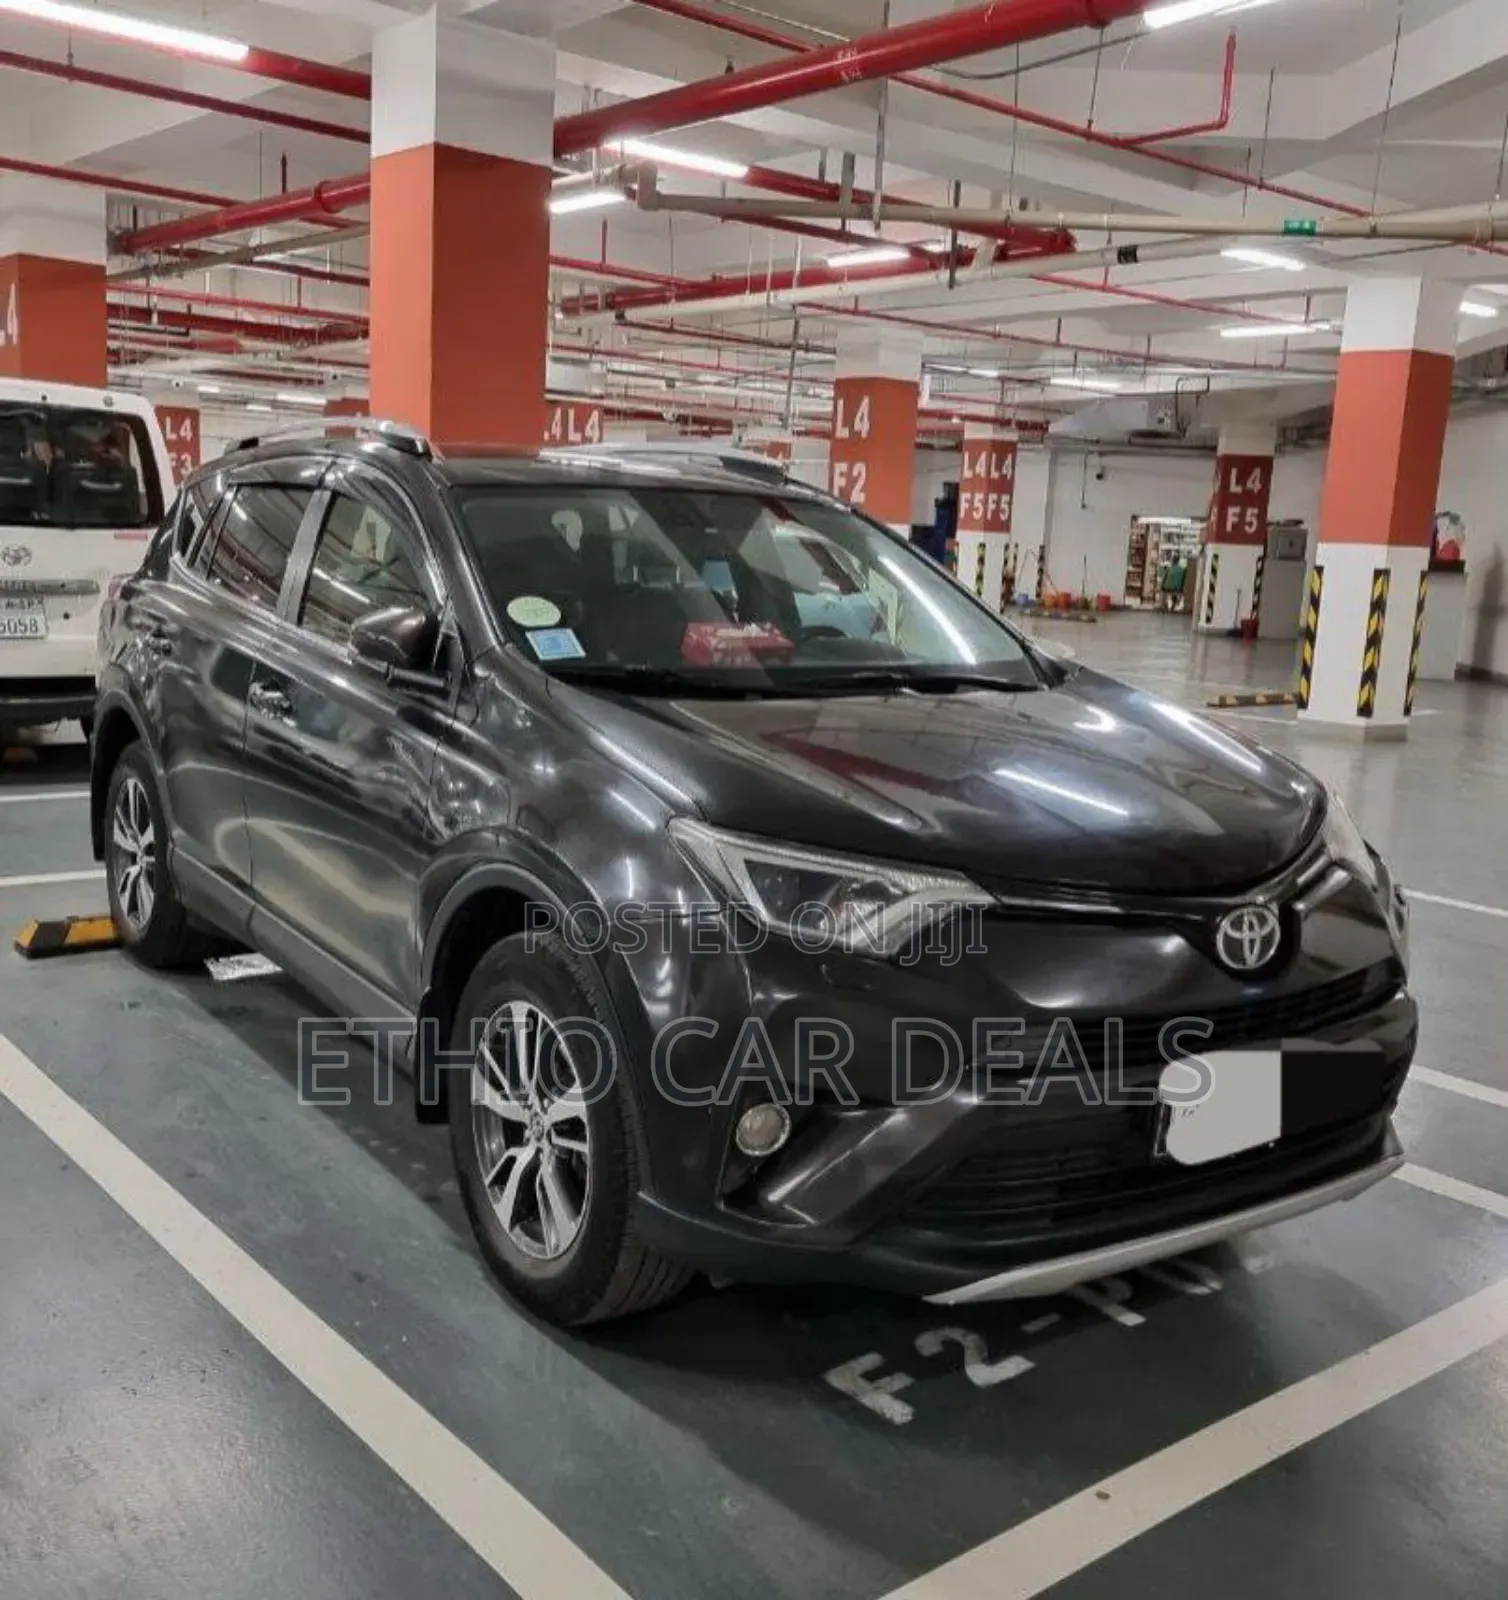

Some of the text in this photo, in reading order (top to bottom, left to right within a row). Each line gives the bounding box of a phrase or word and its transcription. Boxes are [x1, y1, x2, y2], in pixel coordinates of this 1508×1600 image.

[166, 416, 193, 441] L4
[567, 409, 600, 442] L4
[837, 396, 870, 438] L4
[963, 451, 986, 478] L4
[990, 452, 1012, 480] L4
[833, 462, 866, 503] F2
[1230, 467, 1262, 494] L4
[960, 493, 984, 520] F5
[987, 493, 1010, 521] F5
[1226, 506, 1259, 534] F5
